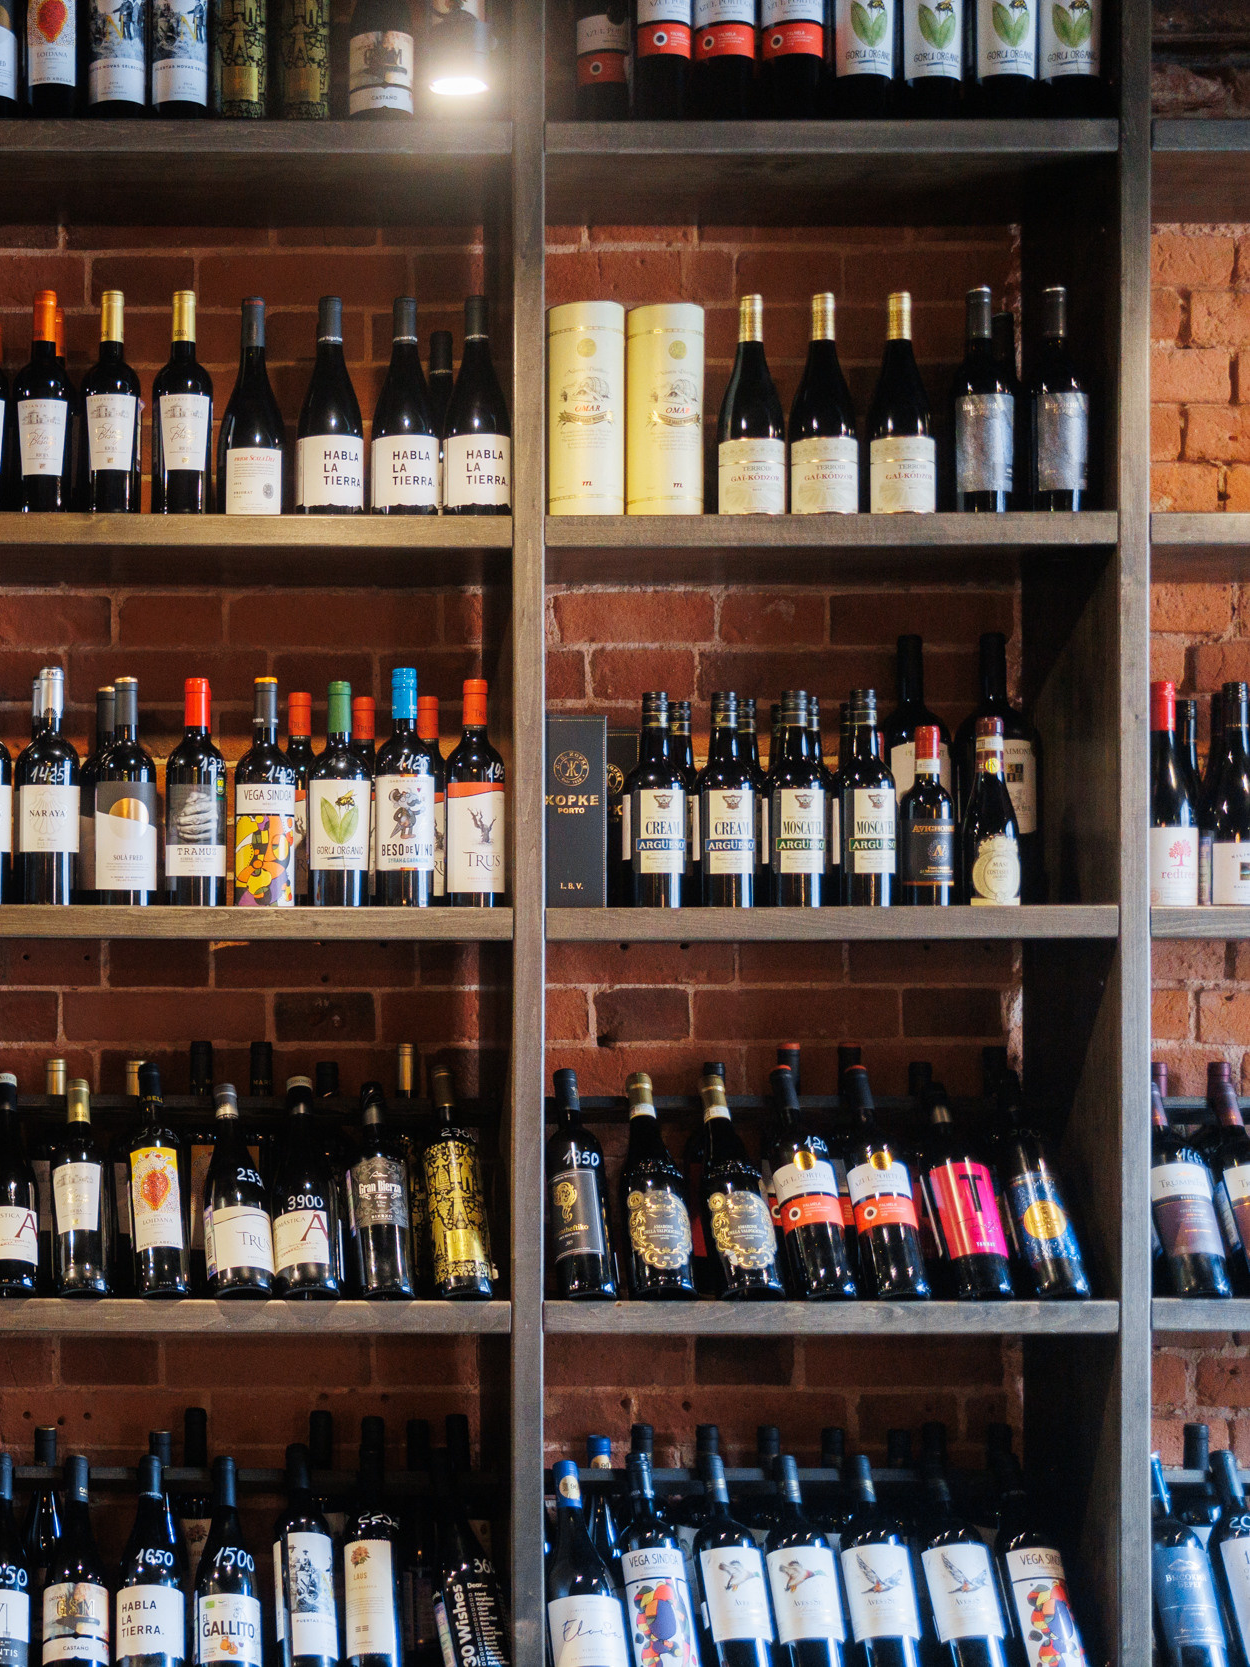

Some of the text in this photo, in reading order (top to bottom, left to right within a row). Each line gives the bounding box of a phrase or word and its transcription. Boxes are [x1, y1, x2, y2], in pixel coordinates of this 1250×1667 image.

[574, 404, 601, 412] OMAR
[665, 406, 691, 414] OMAR
[324, 450, 360, 463] HABLA
[392, 450, 431, 462] HABLA
[466, 449, 504, 462] HABLA
[323, 463, 339, 474] LA
[392, 463, 408, 474] LA
[466, 463, 481, 473] LA
[243, 790, 264, 802] VEGA
[545, 794, 600, 806] KOPKE
[29, 808, 68, 818] NARAYA
[557, 807, 585, 815] PORTO
[645, 821, 682, 836] CREAM
[714, 821, 751, 836] CREAM
[336, 845, 365, 856] ORGANIC
[381, 843, 405, 856] BESO
[406, 845, 414, 854] DE
[638, 839, 685, 851] ARGÜESO
[708, 839, 755, 852] ARGÜESO
[779, 839, 825, 851] ARGÜESO
[463, 850, 502, 872] TRUS
[358, 1182, 377, 1195] Gran
[287, 1194, 325, 1211] 3900
[134, 1547, 175, 1567] 1650
[213, 1546, 256, 1573] 1500
[628, 1552, 650, 1569] VEGA
[1019, 1553, 1045, 1567] VEGA
[56, 1599, 96, 1618] GSM
[121, 1600, 158, 1613] HABLA
[121, 1614, 134, 1626] LA
[202, 1614, 210, 1623] EL
[452, 1583, 473, 1646] Wishes
[202, 1620, 256, 1639] GALLITO
